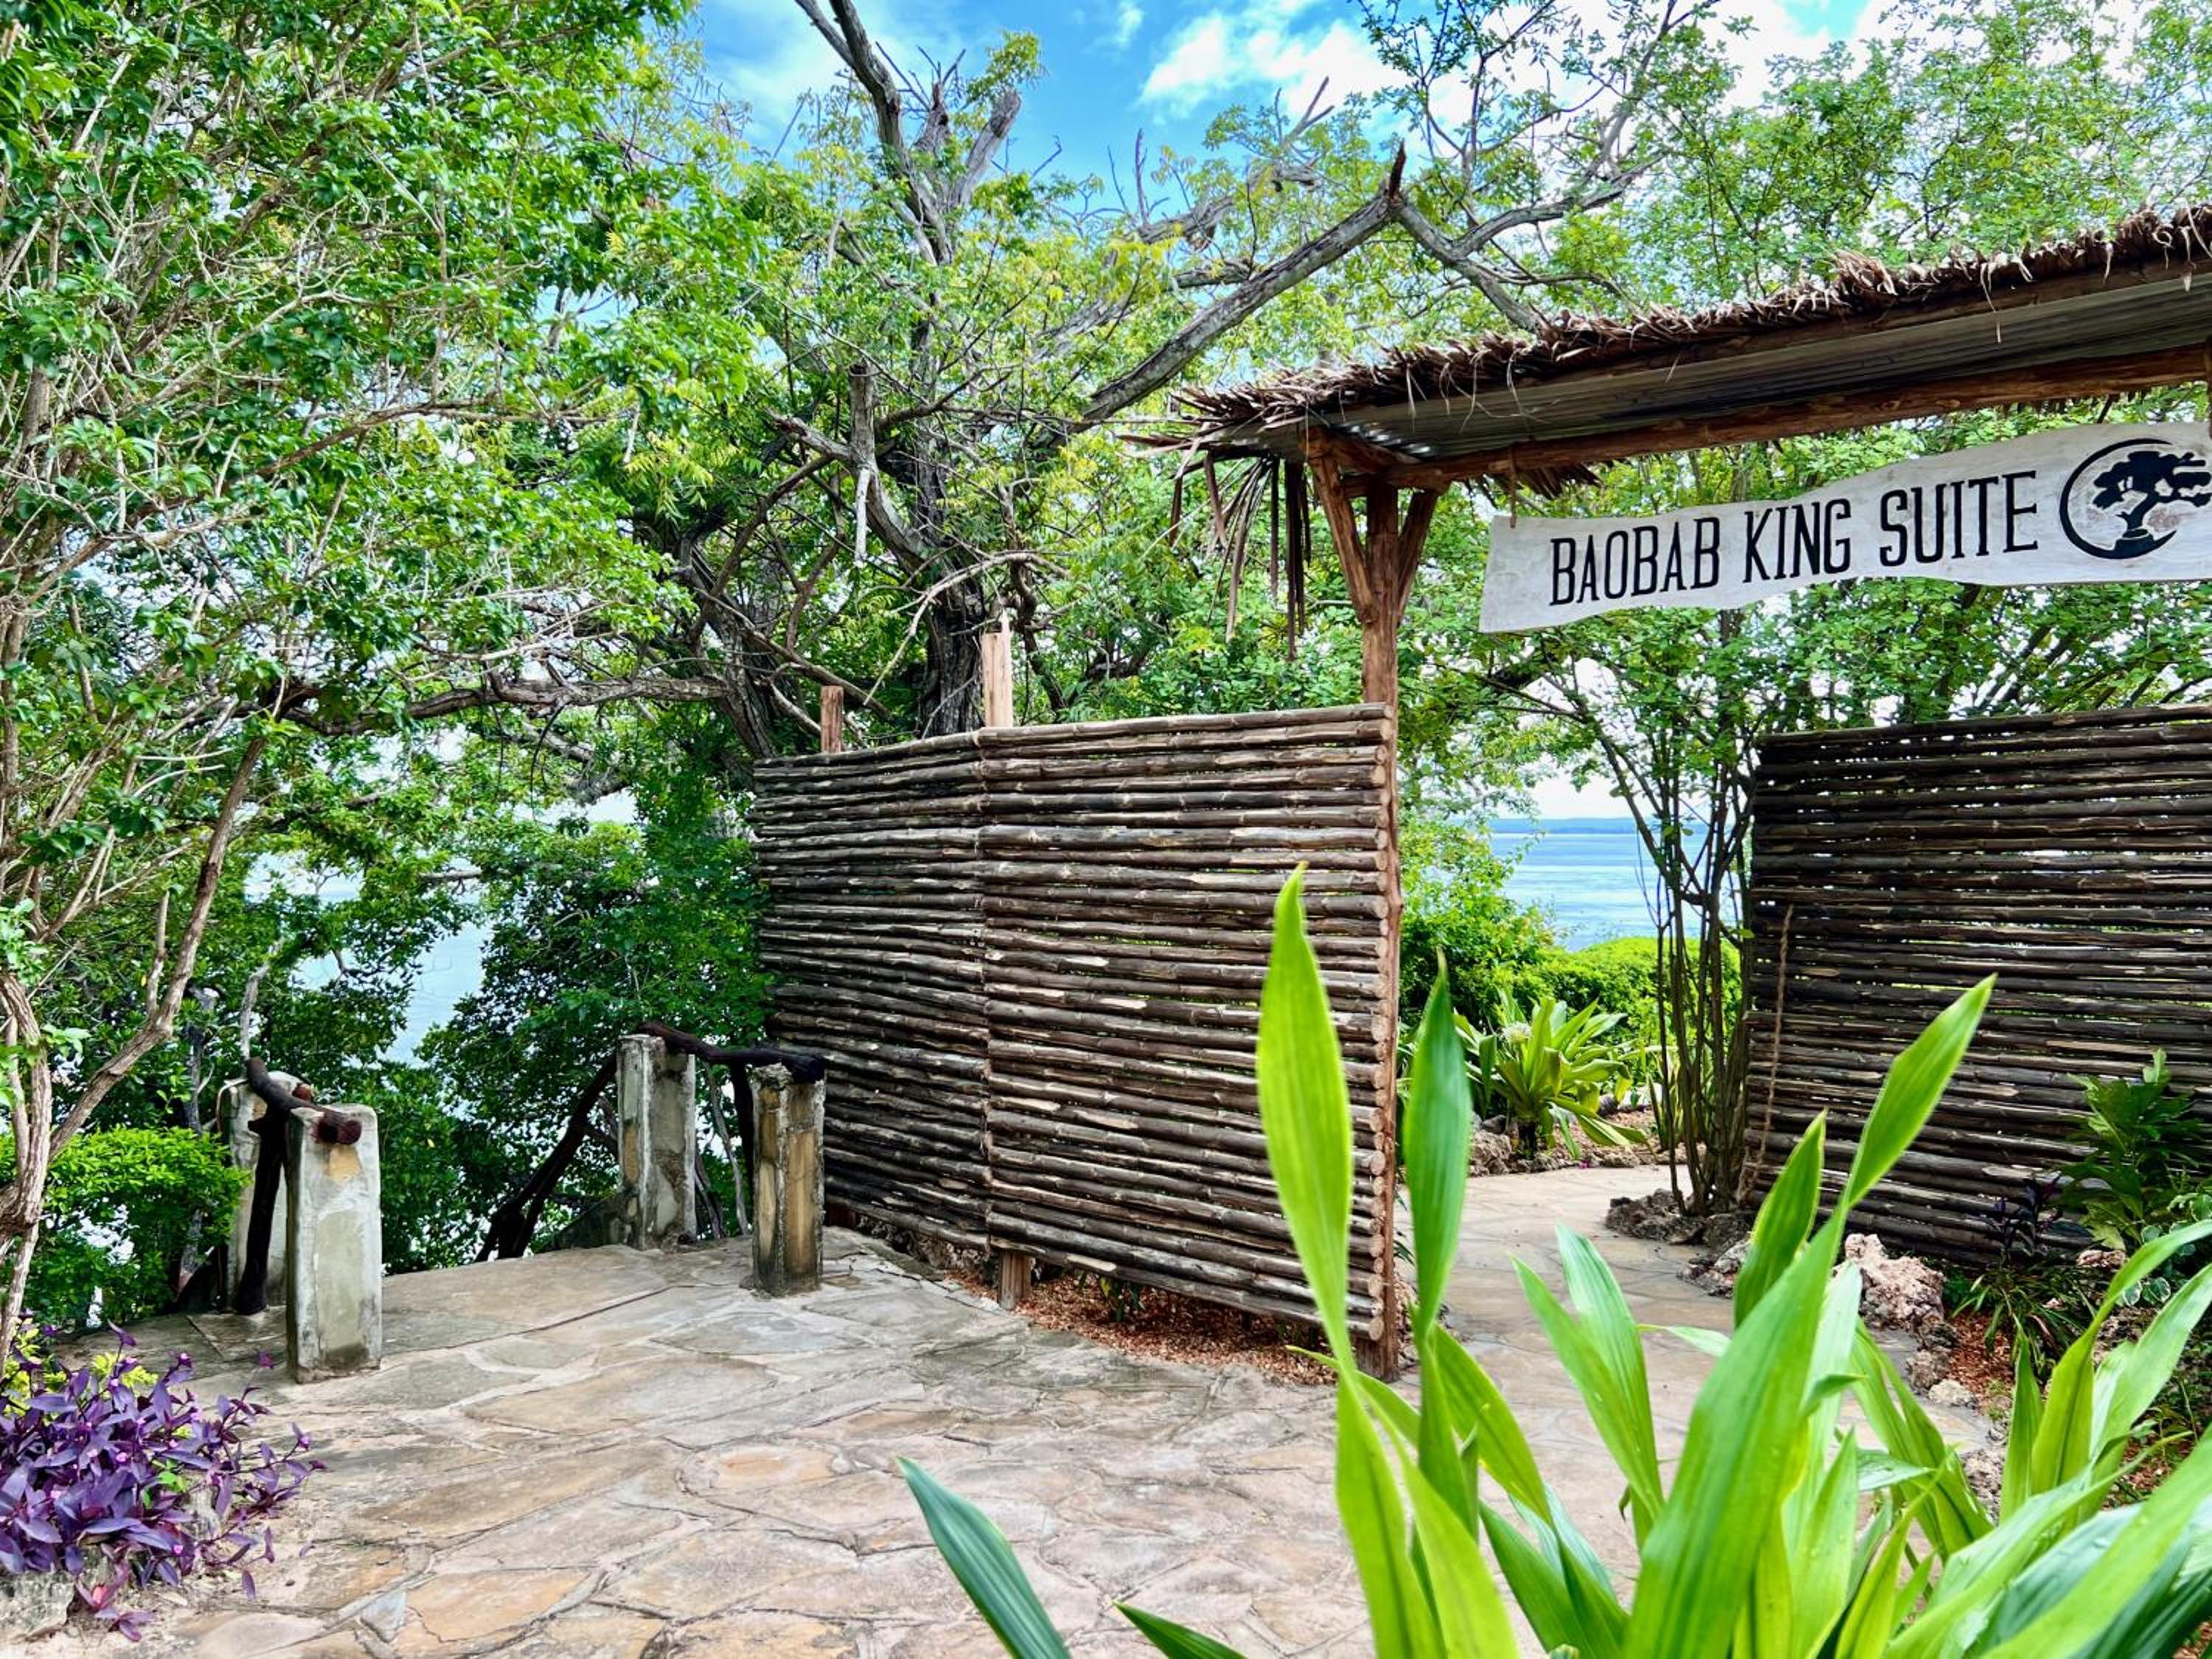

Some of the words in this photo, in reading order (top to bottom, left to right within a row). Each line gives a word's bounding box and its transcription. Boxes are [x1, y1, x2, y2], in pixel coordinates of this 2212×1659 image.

[1549, 517, 1720, 606] BAOBAB
[1742, 498, 1851, 583] KING
[1879, 470, 2039, 567] SUITE
